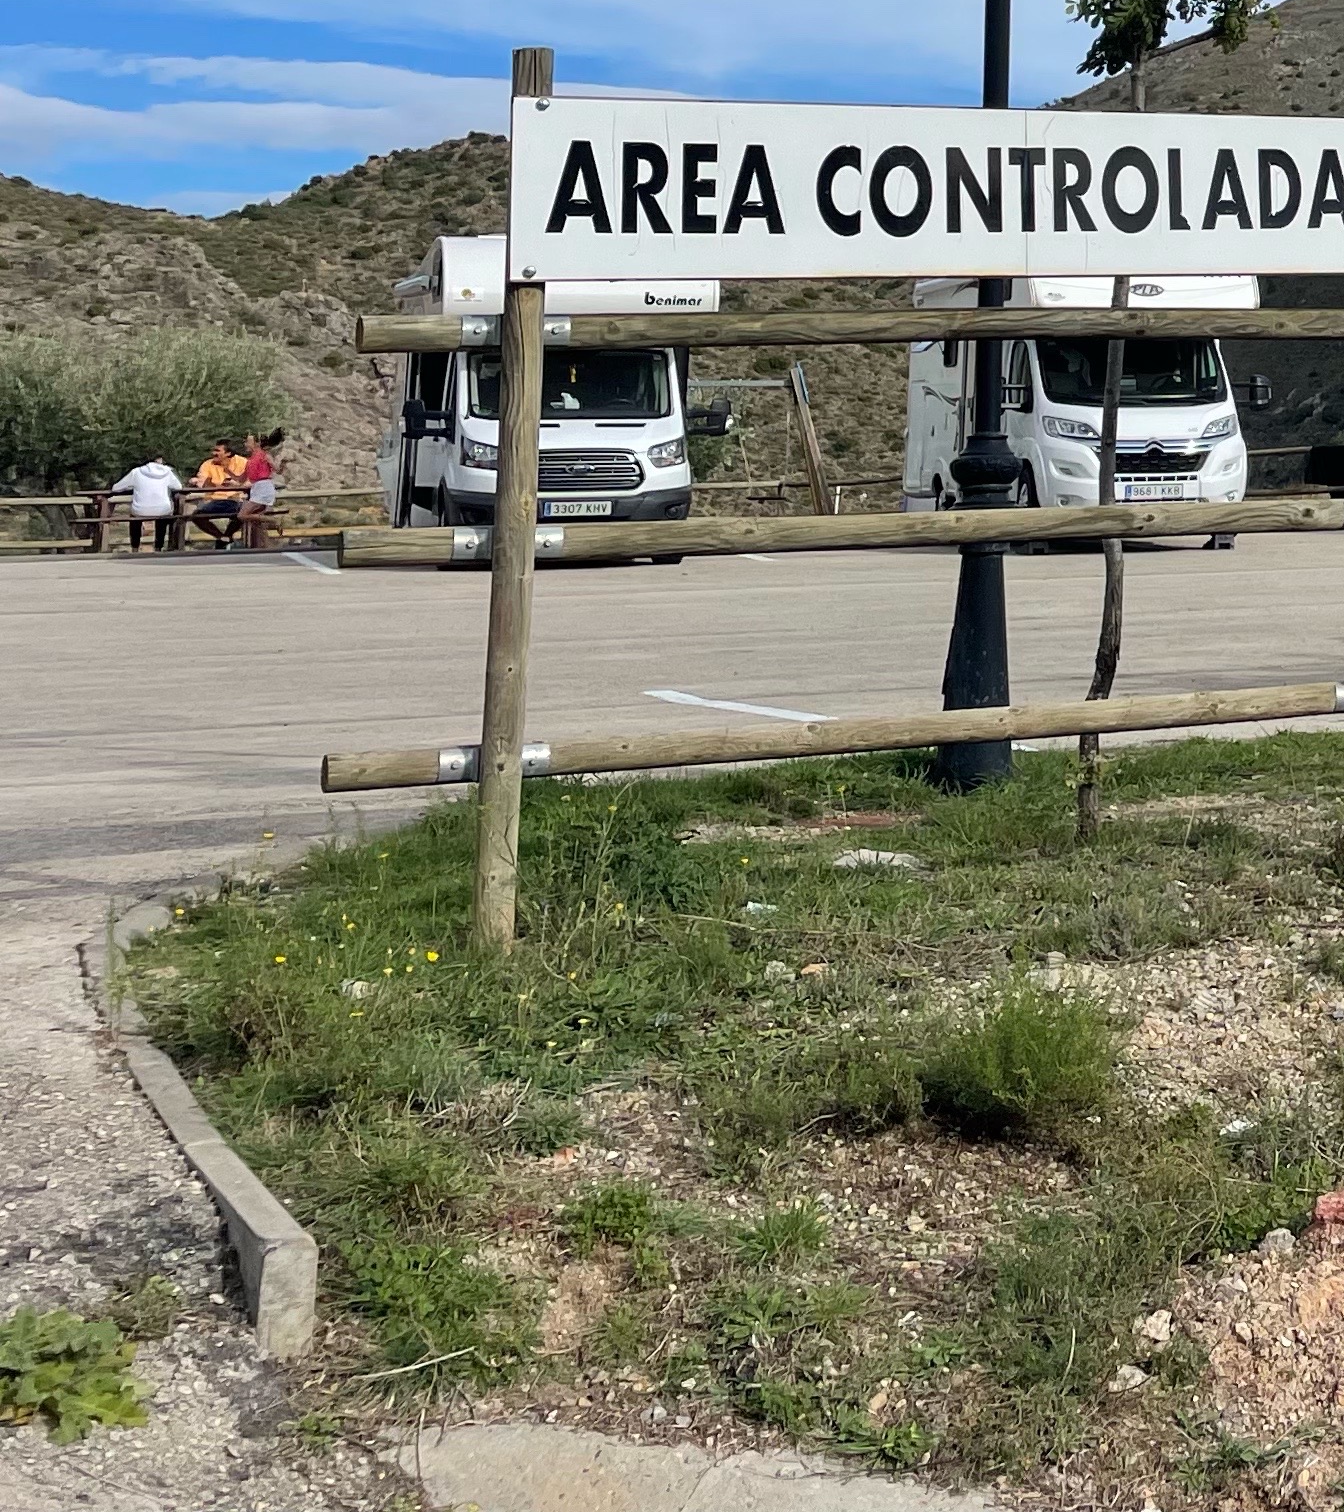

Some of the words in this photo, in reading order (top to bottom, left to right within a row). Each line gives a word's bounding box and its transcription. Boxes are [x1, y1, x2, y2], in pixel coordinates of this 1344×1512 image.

[545, 140, 785, 234] AREA
[644, 291, 702, 306] benimar
[553, 504, 582, 514] 3307
[586, 503, 607, 513] KHV
